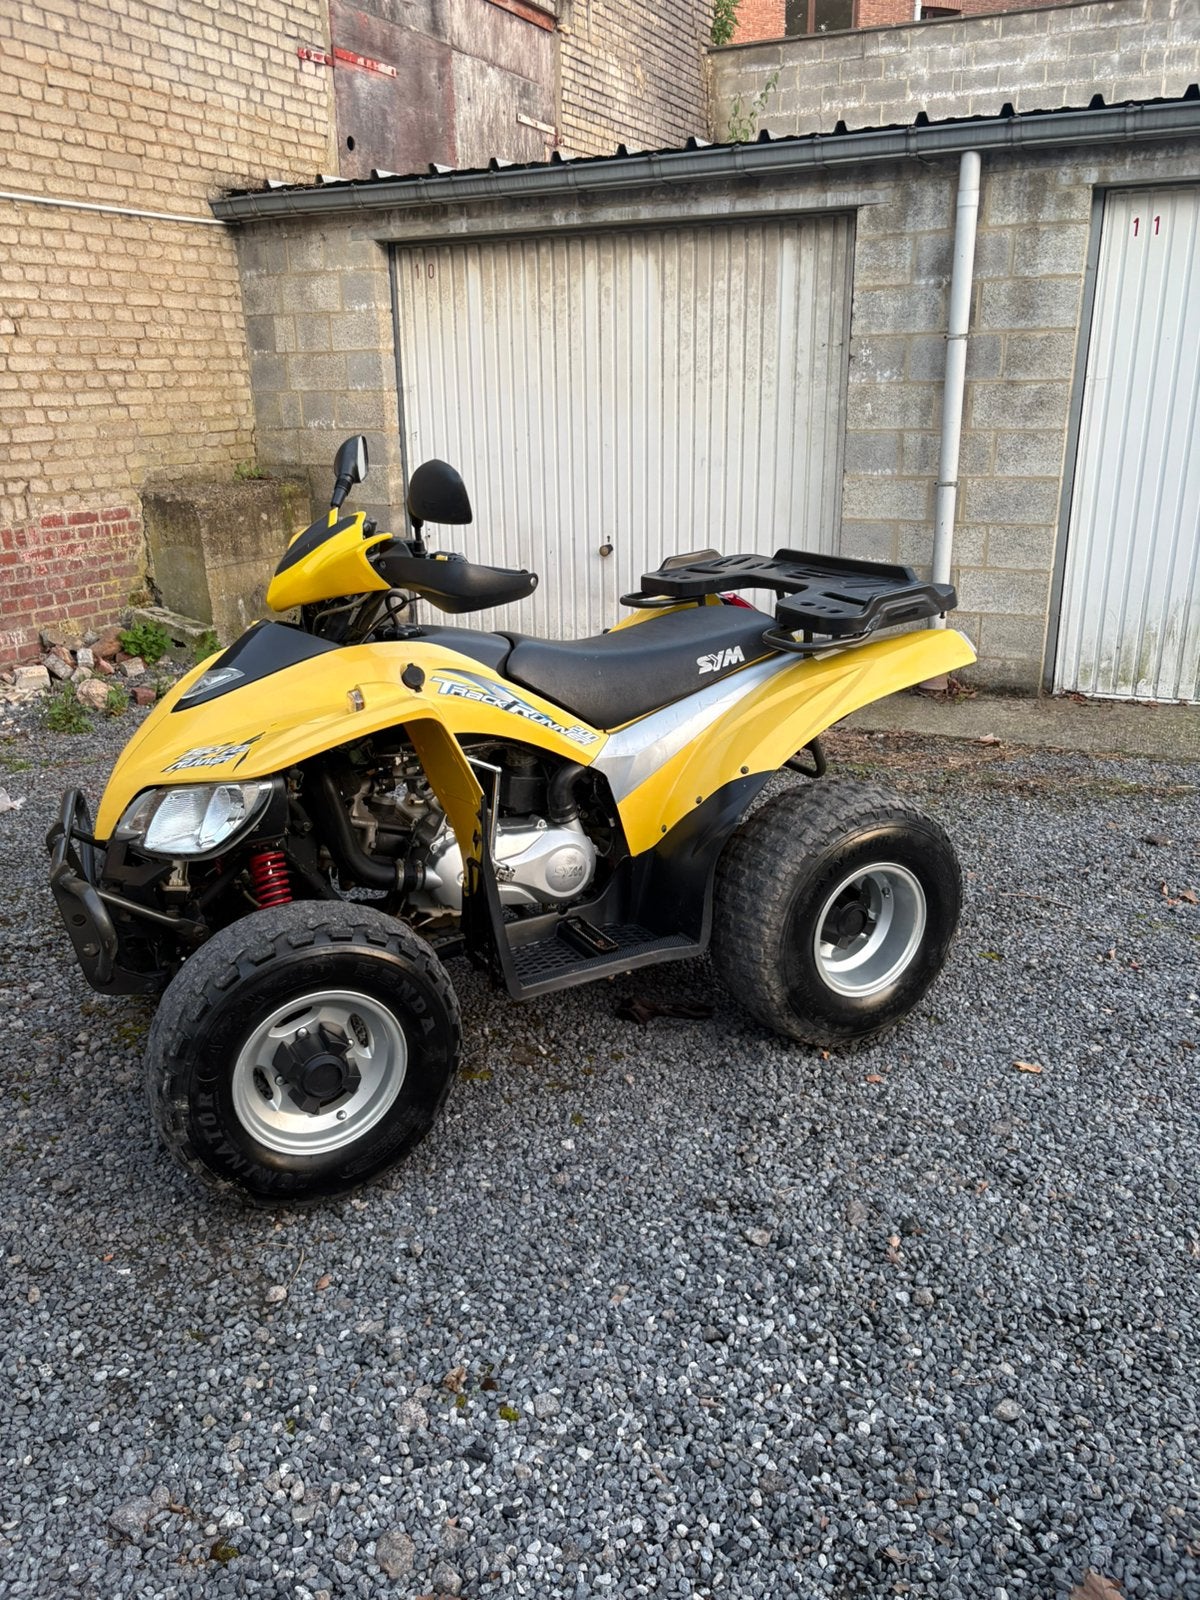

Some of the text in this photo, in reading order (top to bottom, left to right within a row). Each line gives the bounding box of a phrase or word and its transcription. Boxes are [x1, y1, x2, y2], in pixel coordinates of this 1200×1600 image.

[1132, 215, 1161, 237] 11
[415, 263, 435, 280] 10
[696, 645, 746, 675] SYM
